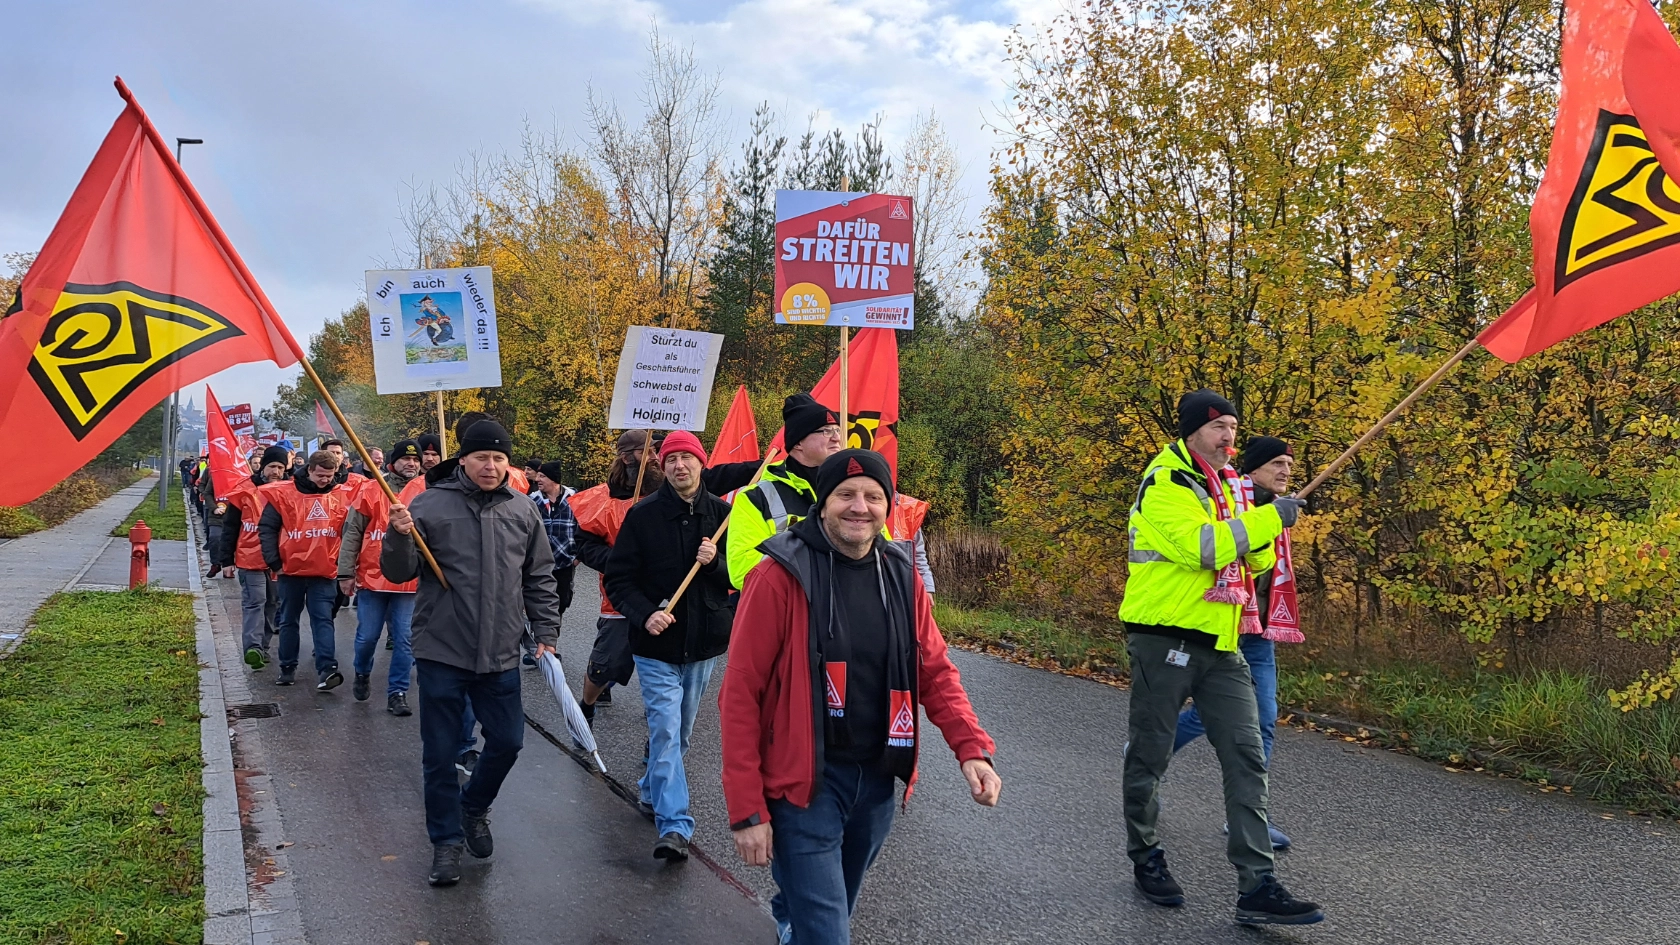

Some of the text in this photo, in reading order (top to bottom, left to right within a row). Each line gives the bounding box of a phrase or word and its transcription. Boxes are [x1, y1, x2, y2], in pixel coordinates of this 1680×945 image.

[817, 218, 881, 240] DAFÜR
[781, 237, 910, 266] STREITEN
[412, 278, 445, 289] auch
[834, 263, 890, 291] WIR
[376, 279, 395, 299] bin
[463, 273, 488, 315] wieder
[865, 306, 902, 314] SOLIDARITÄT
[380, 316, 391, 337] Ich
[477, 318, 488, 335] da
[684, 337, 698, 348] du
[664, 352, 678, 361] als
[635, 362, 701, 375] Geschäftsführer
[633, 380, 697, 393] schwebst du
[650, 395, 675, 405] in die
[632, 407, 681, 425] Holding
[828, 708, 844, 718] RG
